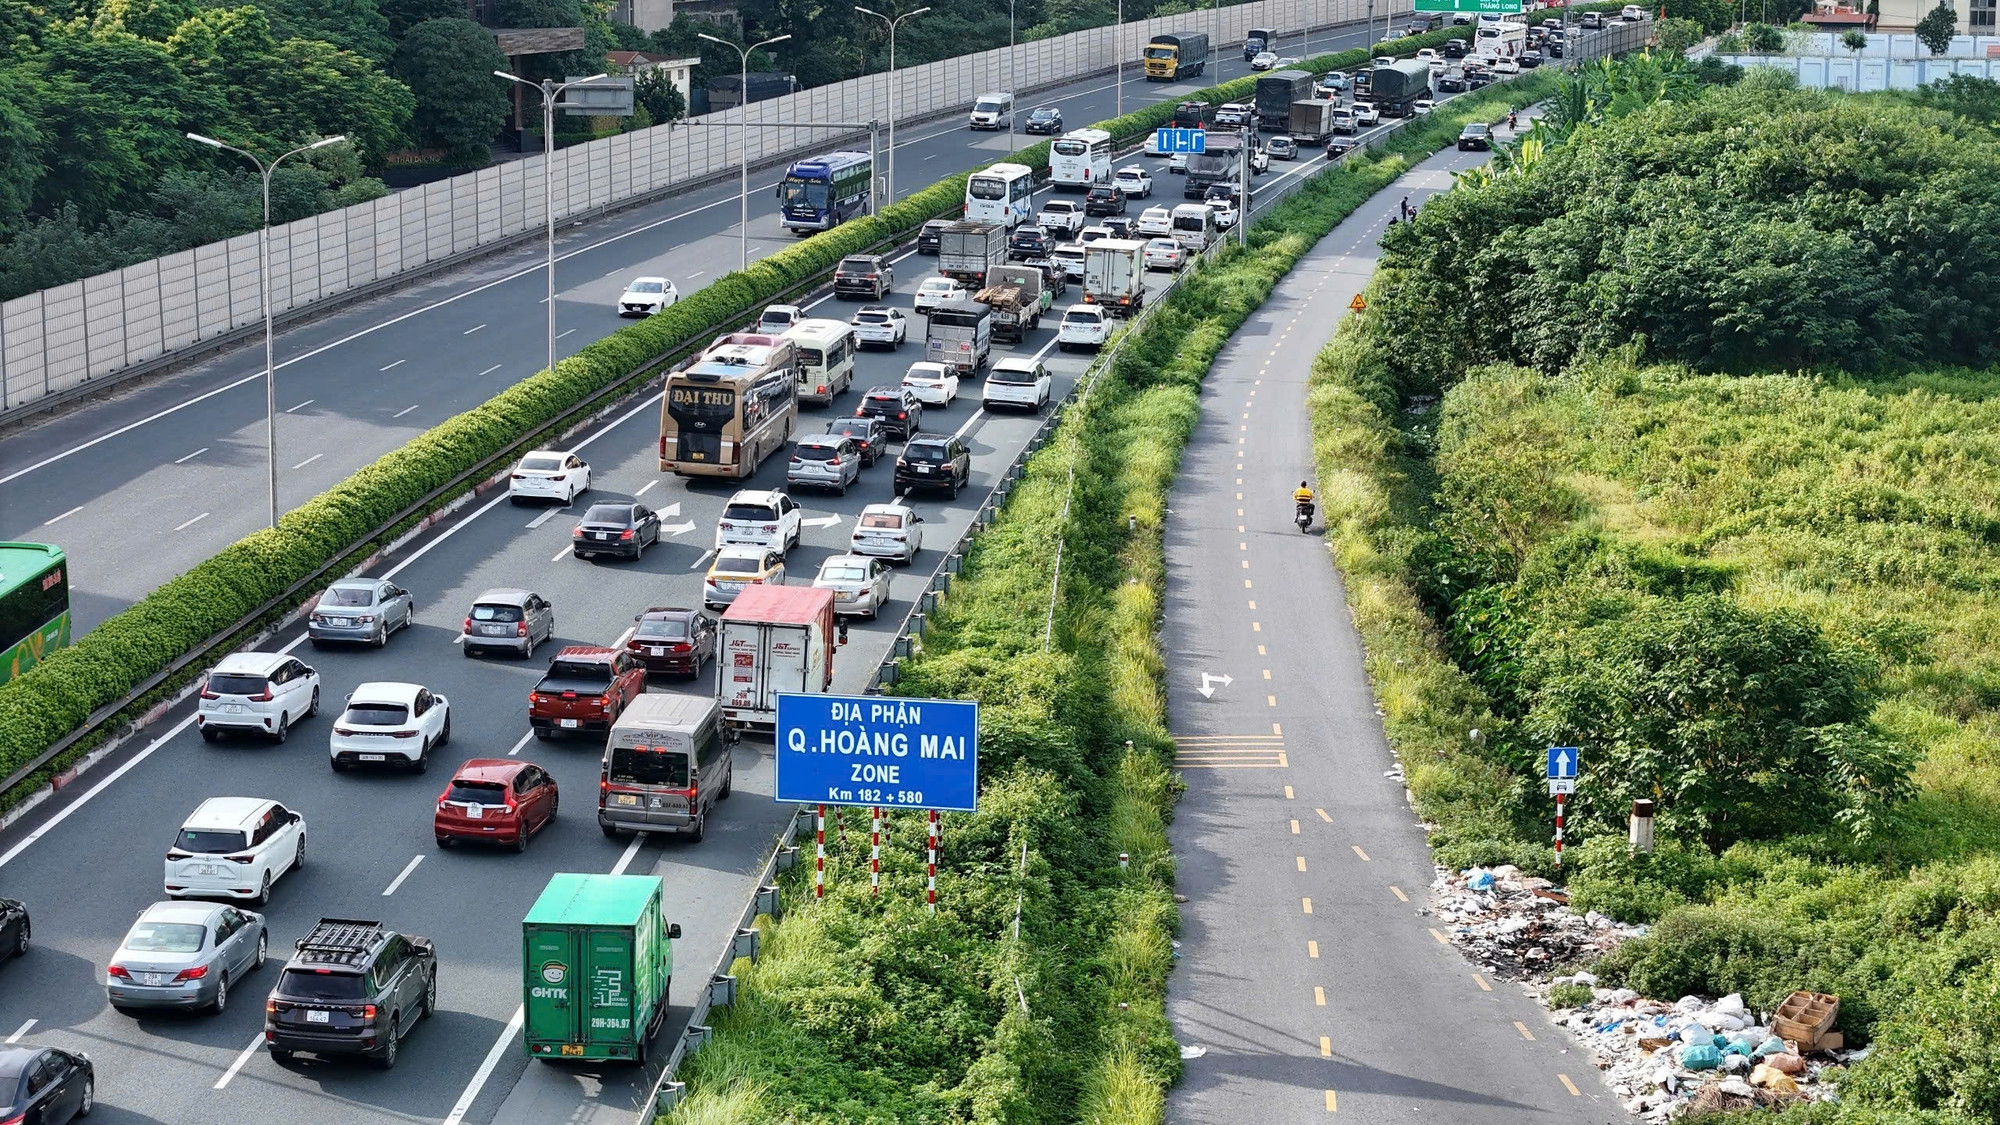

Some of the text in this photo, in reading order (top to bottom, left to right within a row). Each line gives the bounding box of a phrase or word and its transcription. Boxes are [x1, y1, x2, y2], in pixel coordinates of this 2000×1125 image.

[674, 390, 733, 406] ĐẠI THU
[831, 702, 921, 729] ĐỊA PHẬN
[920, 734, 965, 760] MAI
[851, 763, 900, 784] ZONE
[829, 787, 852, 801] Km
[857, 788, 881, 802] 182
[897, 790, 923, 804] 580
[531, 987, 568, 999] GHTK
[591, 1018, 630, 1028] 29H-364.97
